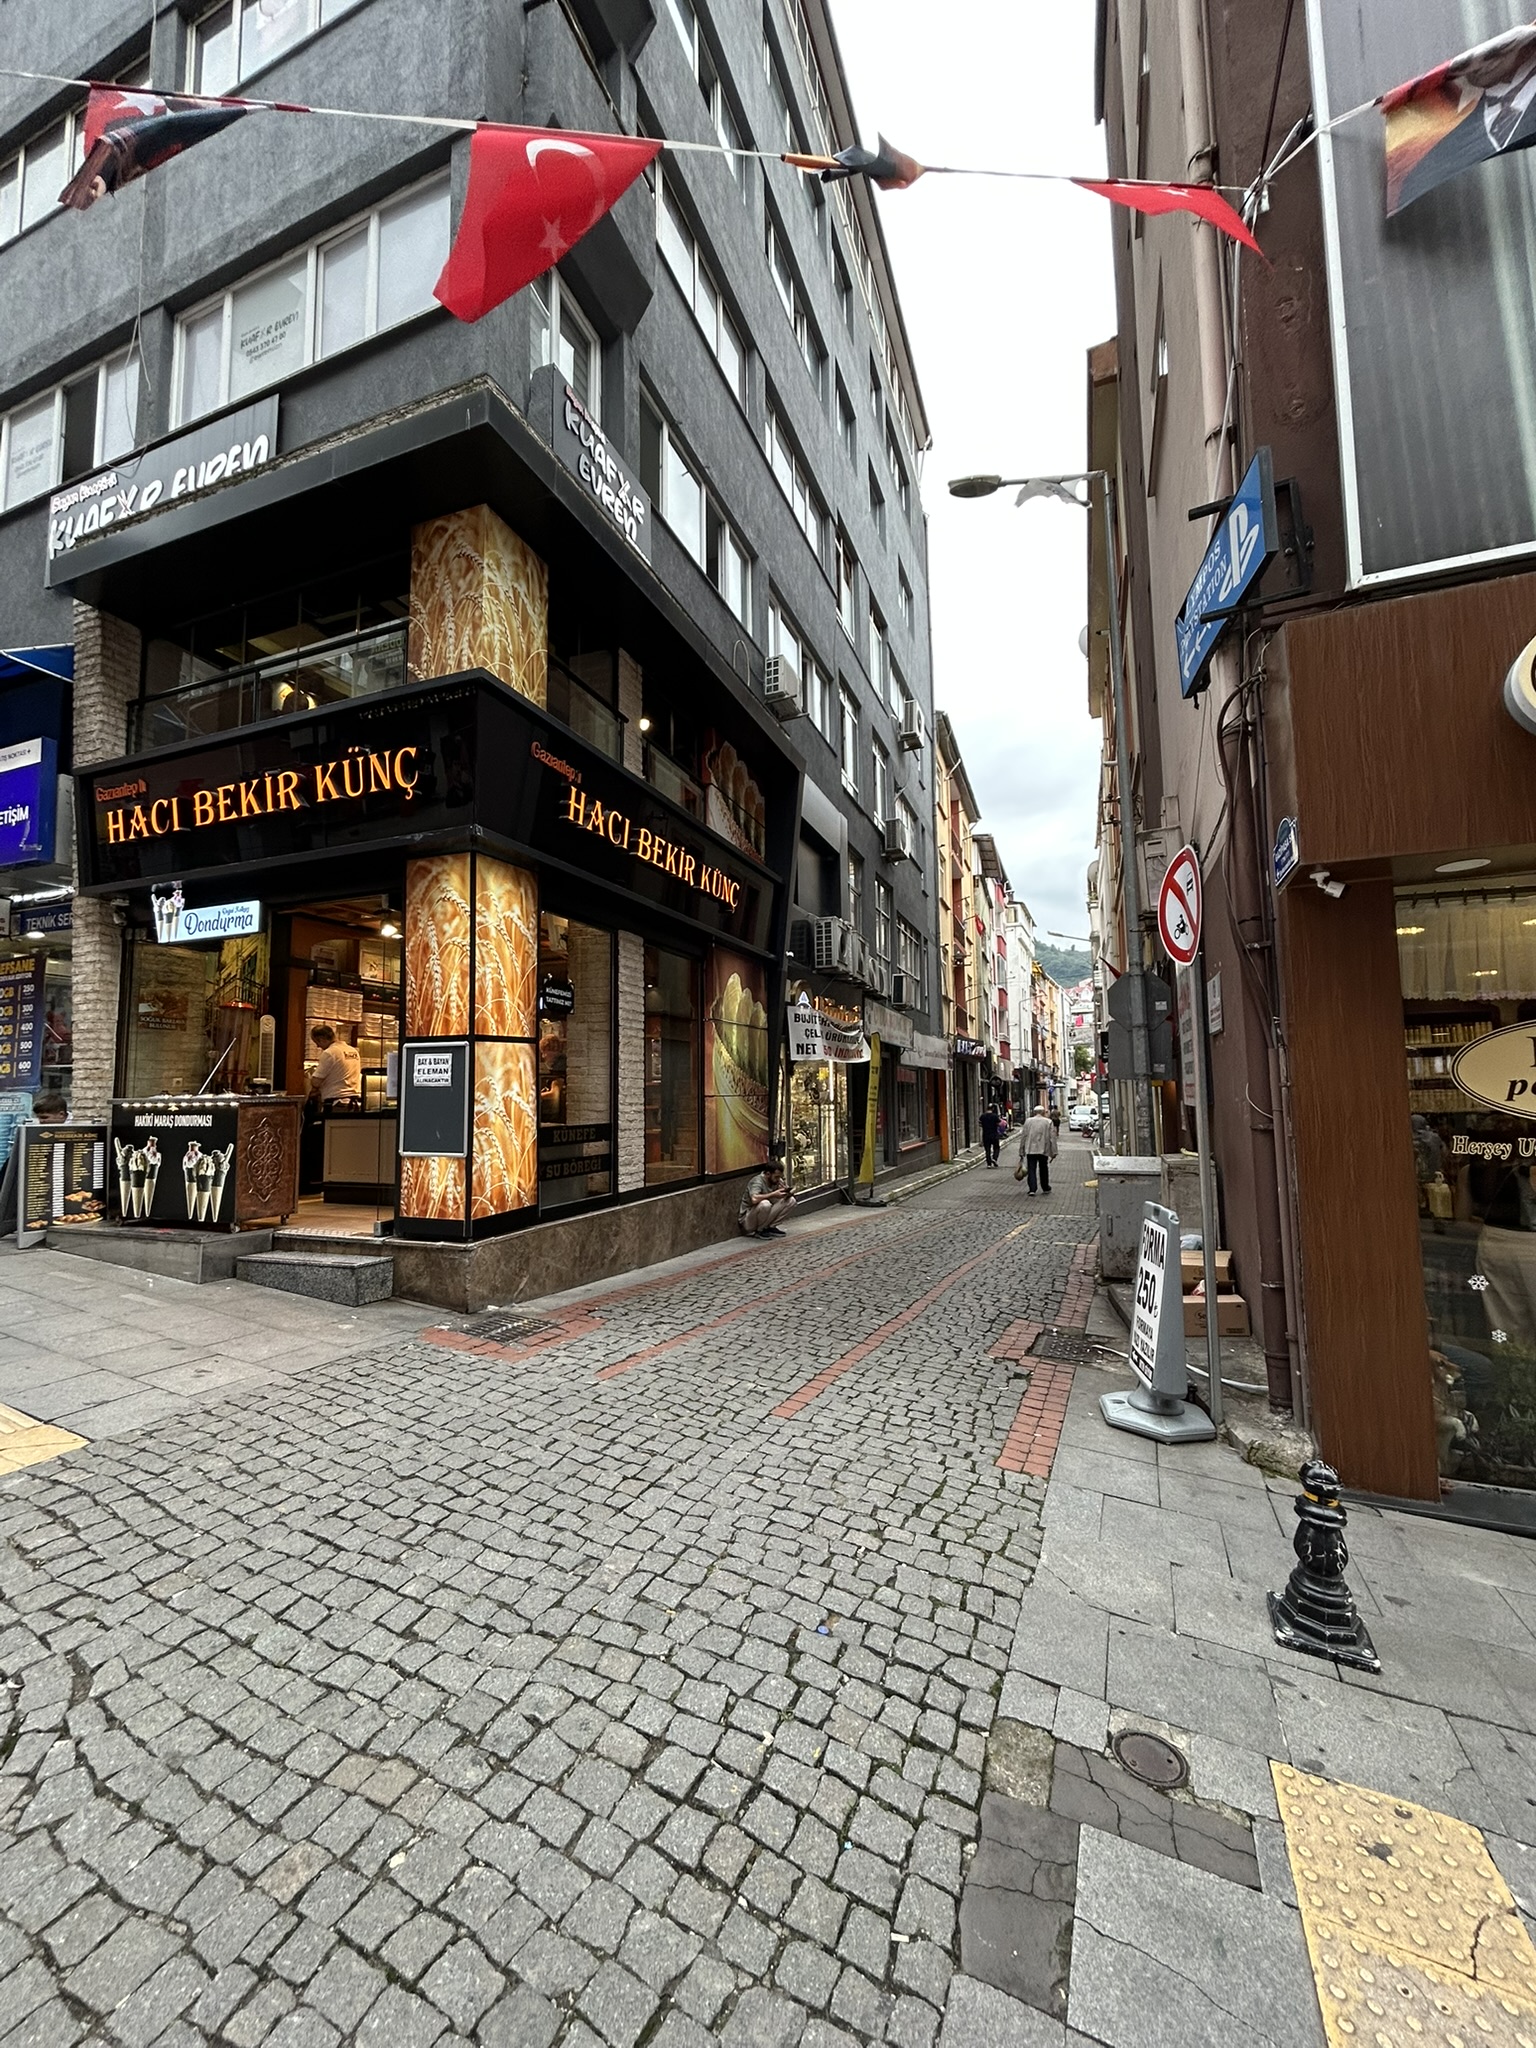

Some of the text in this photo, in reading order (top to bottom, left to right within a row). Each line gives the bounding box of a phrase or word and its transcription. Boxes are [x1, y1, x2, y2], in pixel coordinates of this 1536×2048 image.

[578, 453, 637, 541] EVREN
[107, 746, 420, 844] HACI BEKİR KÜNÇ
[567, 785, 740, 914] HACI BEKİR KÜNÇ
[26, 912, 57, 931] TEKNİK
[184, 911, 253, 935] Dondurma
[22, 984, 35, 993] 250
[22, 1004, 34, 1013] 300
[20, 1022, 33, 1031] 400
[20, 1041, 33, 1050] 500
[796, 1043, 817, 1055] NET
[18, 1061, 31, 1070] 600
[417, 1058, 428, 1066] BAY
[433, 1057, 450, 1066] BAYAN
[154, 1114, 175, 1128] MARAŞ
[174, 1114, 213, 1127] DONDURMASI
[552, 1126, 596, 1143] KÜNEFE
[1452, 1135, 1512, 1160] Herşey
[545, 1155, 602, 1178] SU BÖREĞİ
[1143, 1224, 1165, 1270] FORMA
